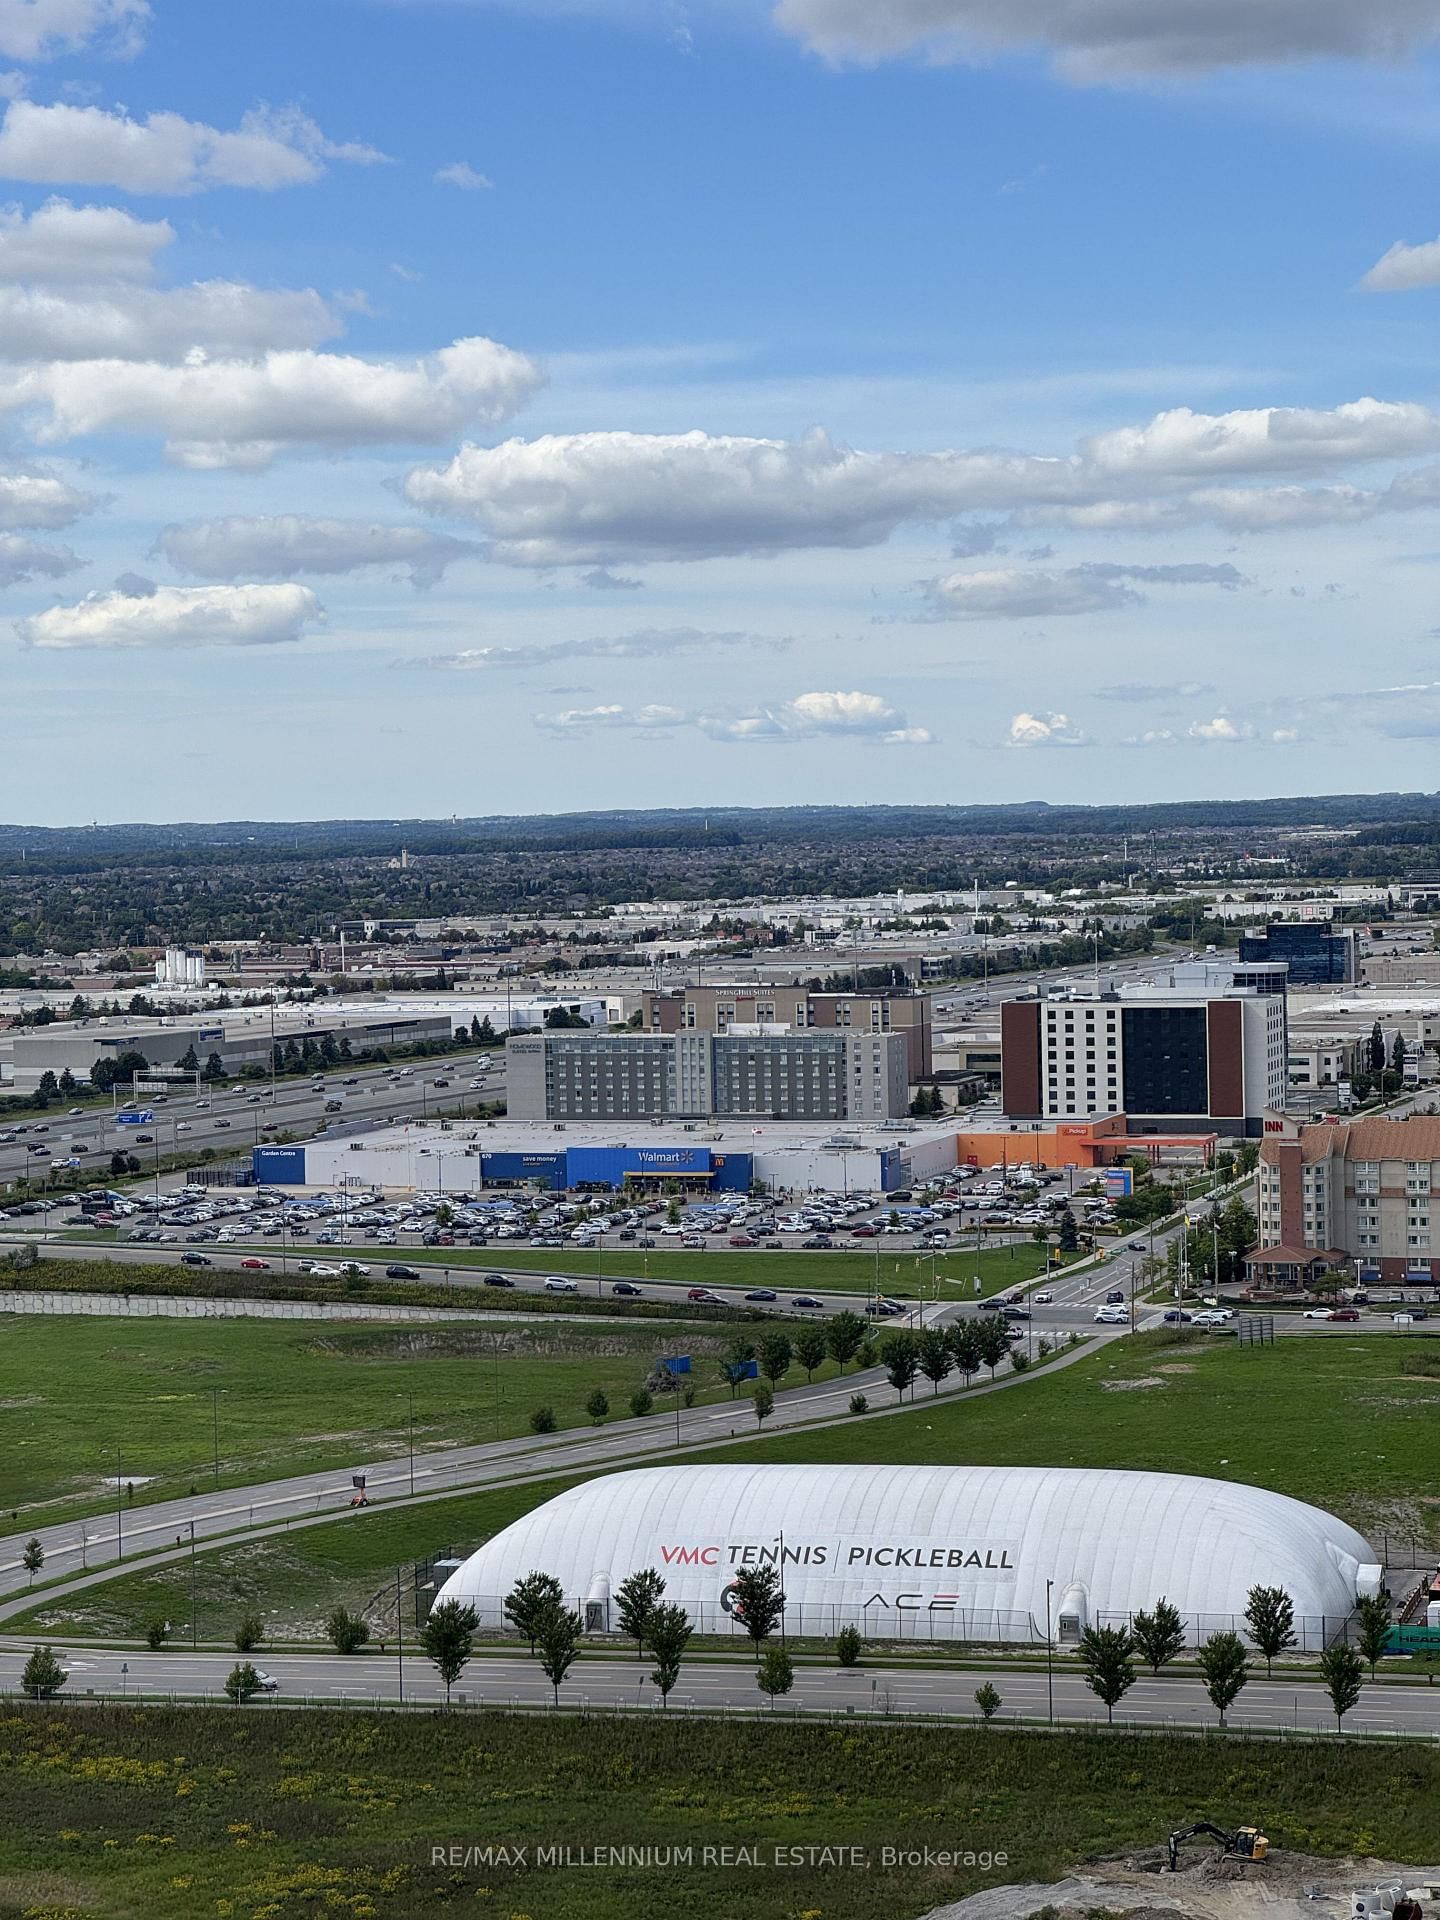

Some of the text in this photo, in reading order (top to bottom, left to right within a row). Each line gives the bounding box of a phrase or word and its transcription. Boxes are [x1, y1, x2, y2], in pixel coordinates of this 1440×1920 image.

[1264, 1121, 1284, 1132] INN
[638, 1151, 680, 1162] Walmart
[661, 1545, 1014, 1569] VMC TENNIS PICKLEBALL
[862, 1593, 960, 1611] ACE
